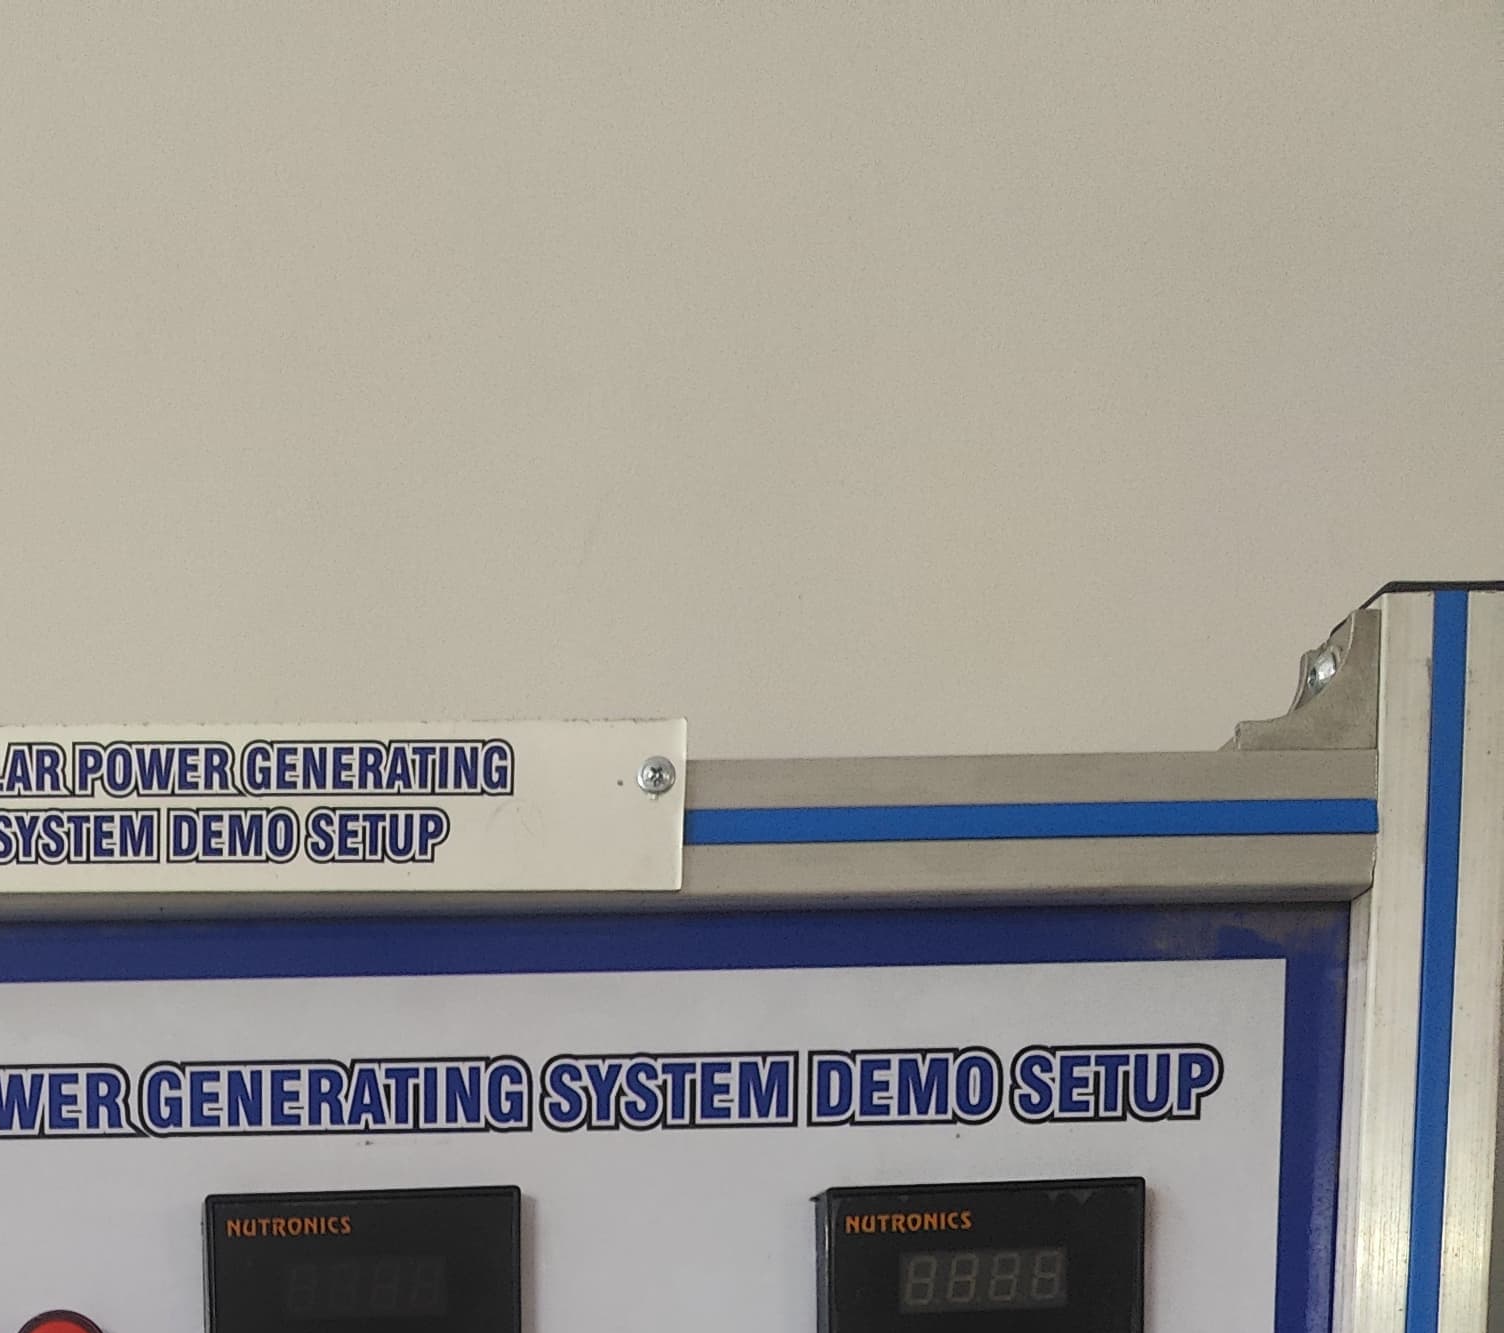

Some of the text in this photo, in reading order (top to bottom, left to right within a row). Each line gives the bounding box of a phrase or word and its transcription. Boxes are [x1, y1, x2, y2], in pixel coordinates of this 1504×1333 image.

[71, 741, 235, 798] POWER
[242, 740, 513, 796] GENERATING
[168, 808, 299, 863] DEMO
[304, 807, 448, 863] SETUP
[139, 1057, 534, 1138] GENERATING
[541, 1052, 799, 1132] SYSTEM
[808, 1048, 1006, 1127] DEMO
[1009, 1044, 1224, 1122] SETUP
[226, 1216, 352, 1238] NUTRONICS
[845, 1211, 973, 1234] NUTRONICS
